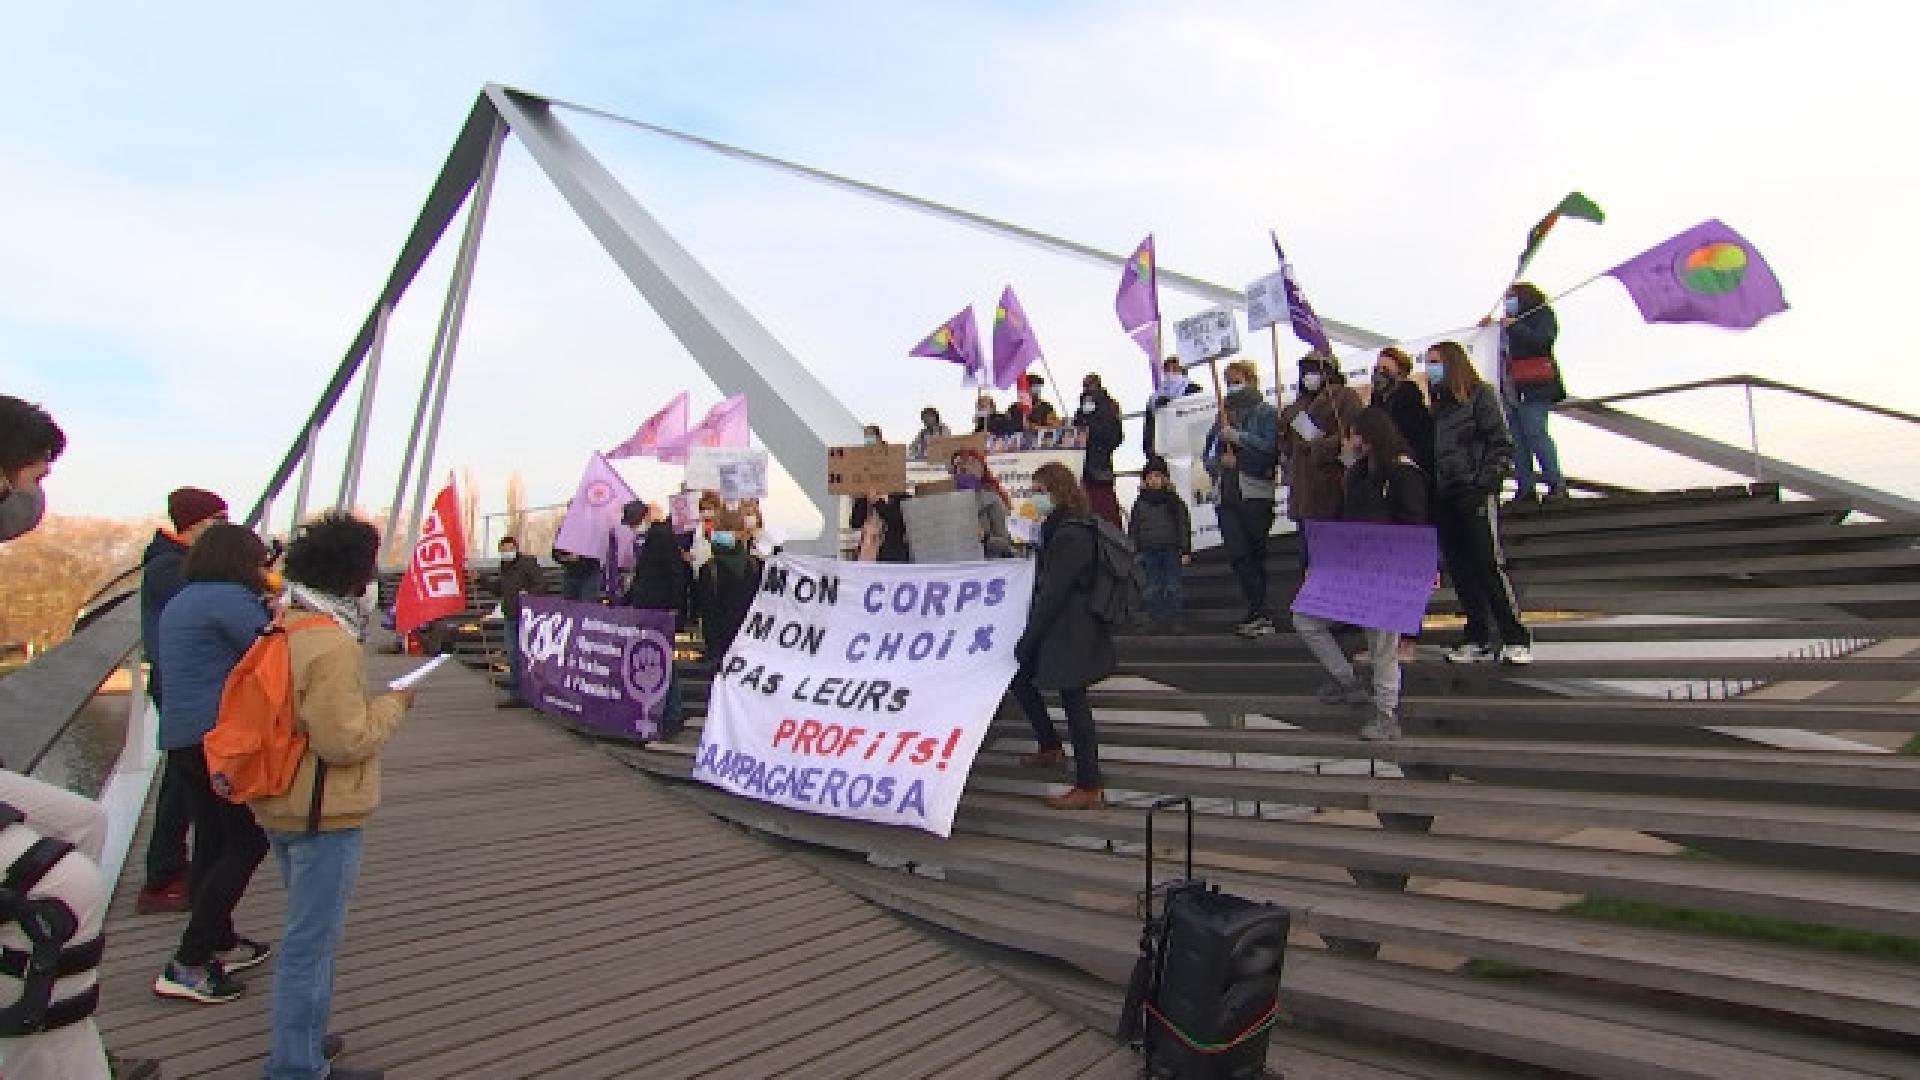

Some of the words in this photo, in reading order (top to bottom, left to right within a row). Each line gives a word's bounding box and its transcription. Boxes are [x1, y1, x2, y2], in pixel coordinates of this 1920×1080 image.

[762, 566, 840, 604] MON
[863, 578, 1006, 616] CORPS
[746, 612, 825, 656] MON
[722, 656, 784, 694] PAS
[792, 677, 911, 712] LEURS
[699, 742, 925, 817] AMPAGNEROSA
